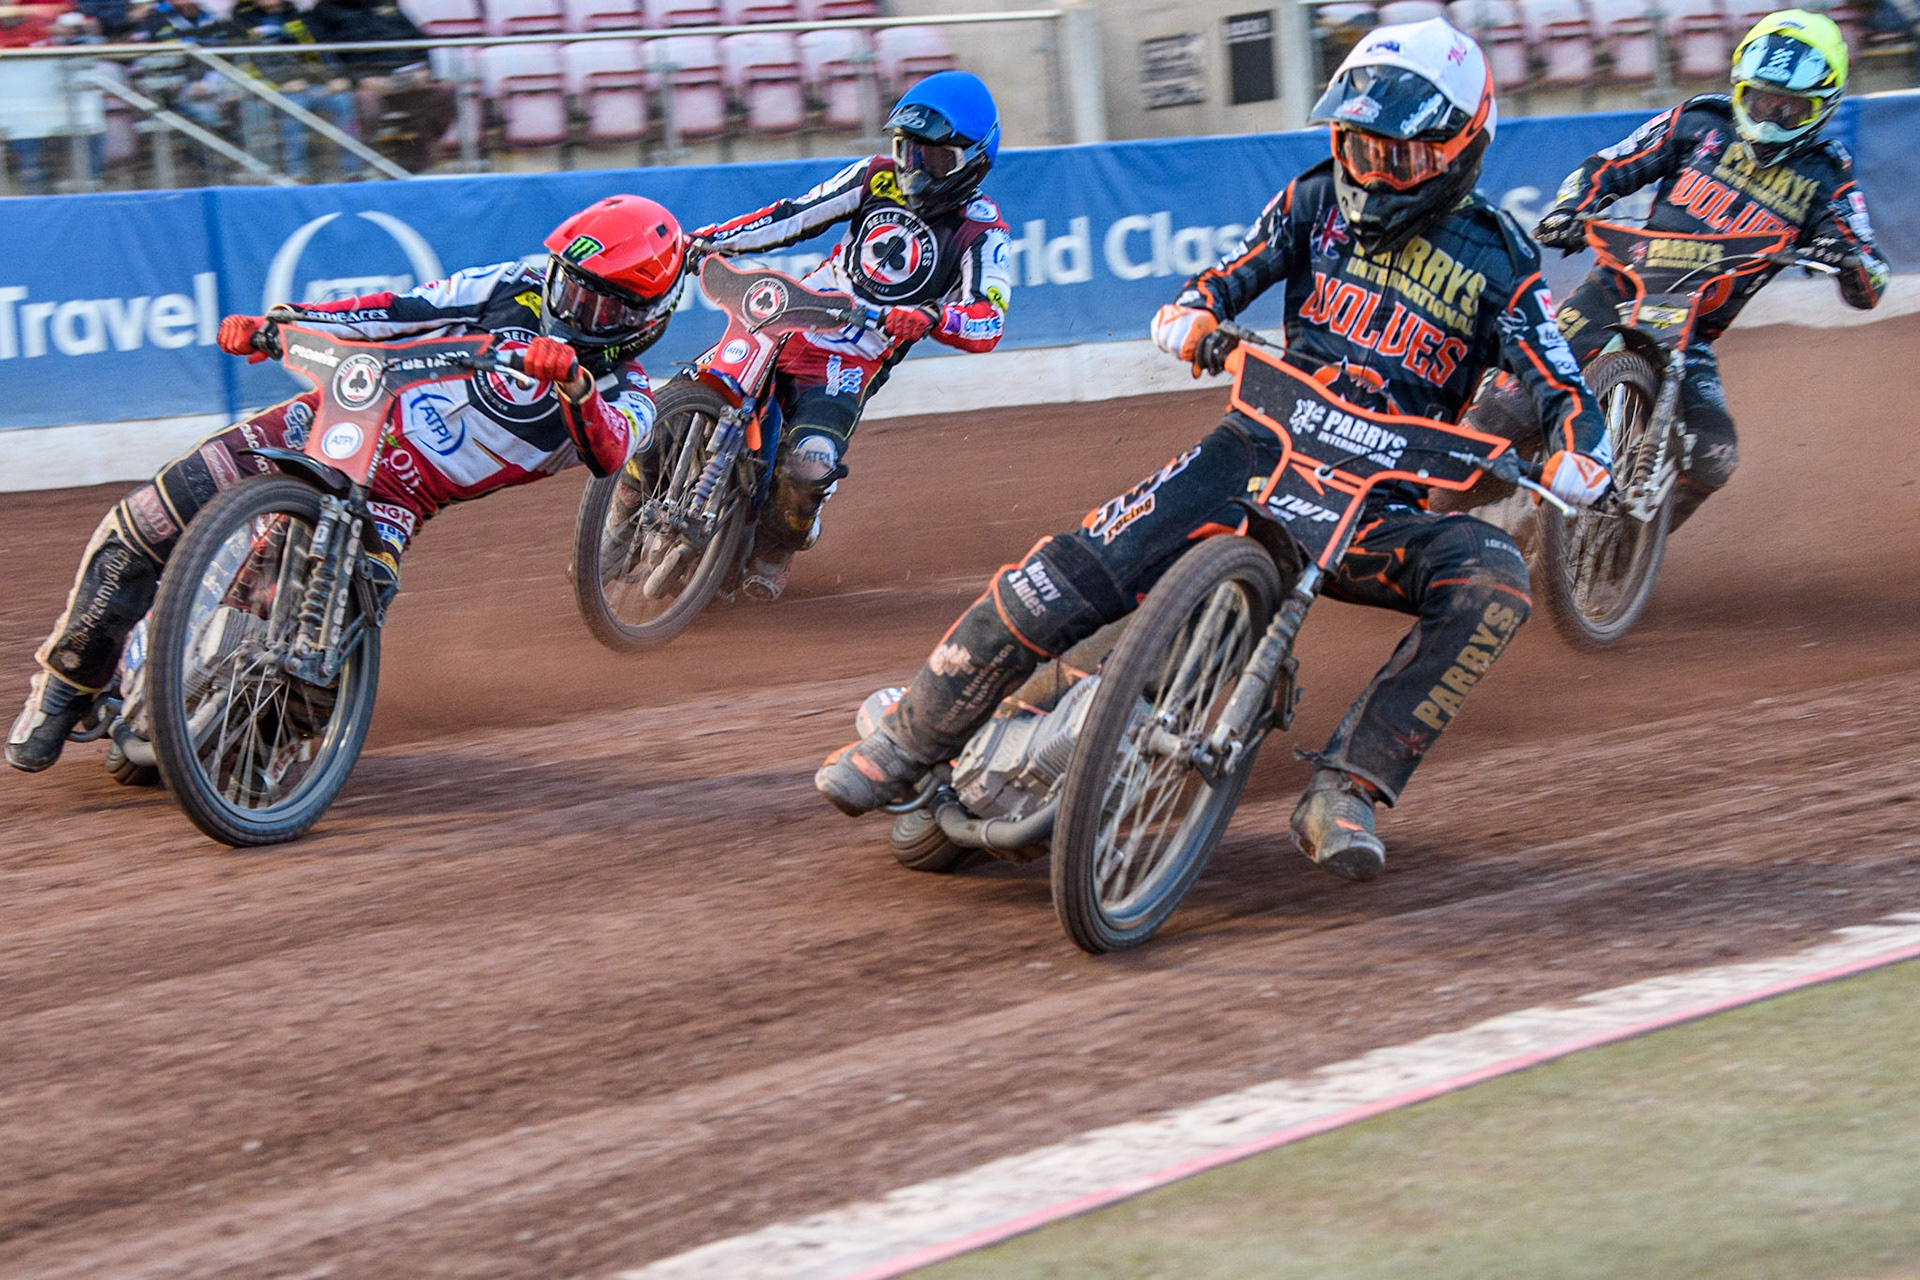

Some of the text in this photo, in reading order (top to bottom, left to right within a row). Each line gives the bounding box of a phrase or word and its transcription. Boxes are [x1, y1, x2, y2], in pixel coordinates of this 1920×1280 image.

[867, 213, 900, 231] BELLE
[921, 236, 934, 267] ACES
[1010, 211, 1249, 287] rld Clas
[0, 271, 219, 360] Travel
[503, 330, 533, 343] BELL
[419, 404, 454, 445] ATPI
[1322, 409, 1408, 459] PARRYS
[372, 503, 412, 528] NGK
[1105, 496, 1154, 543] racing
[1268, 493, 1341, 523] JWP
[1007, 570, 1047, 617] & Jules
[1025, 561, 1062, 601] Harry
[1412, 602, 1515, 731] PARRYS
